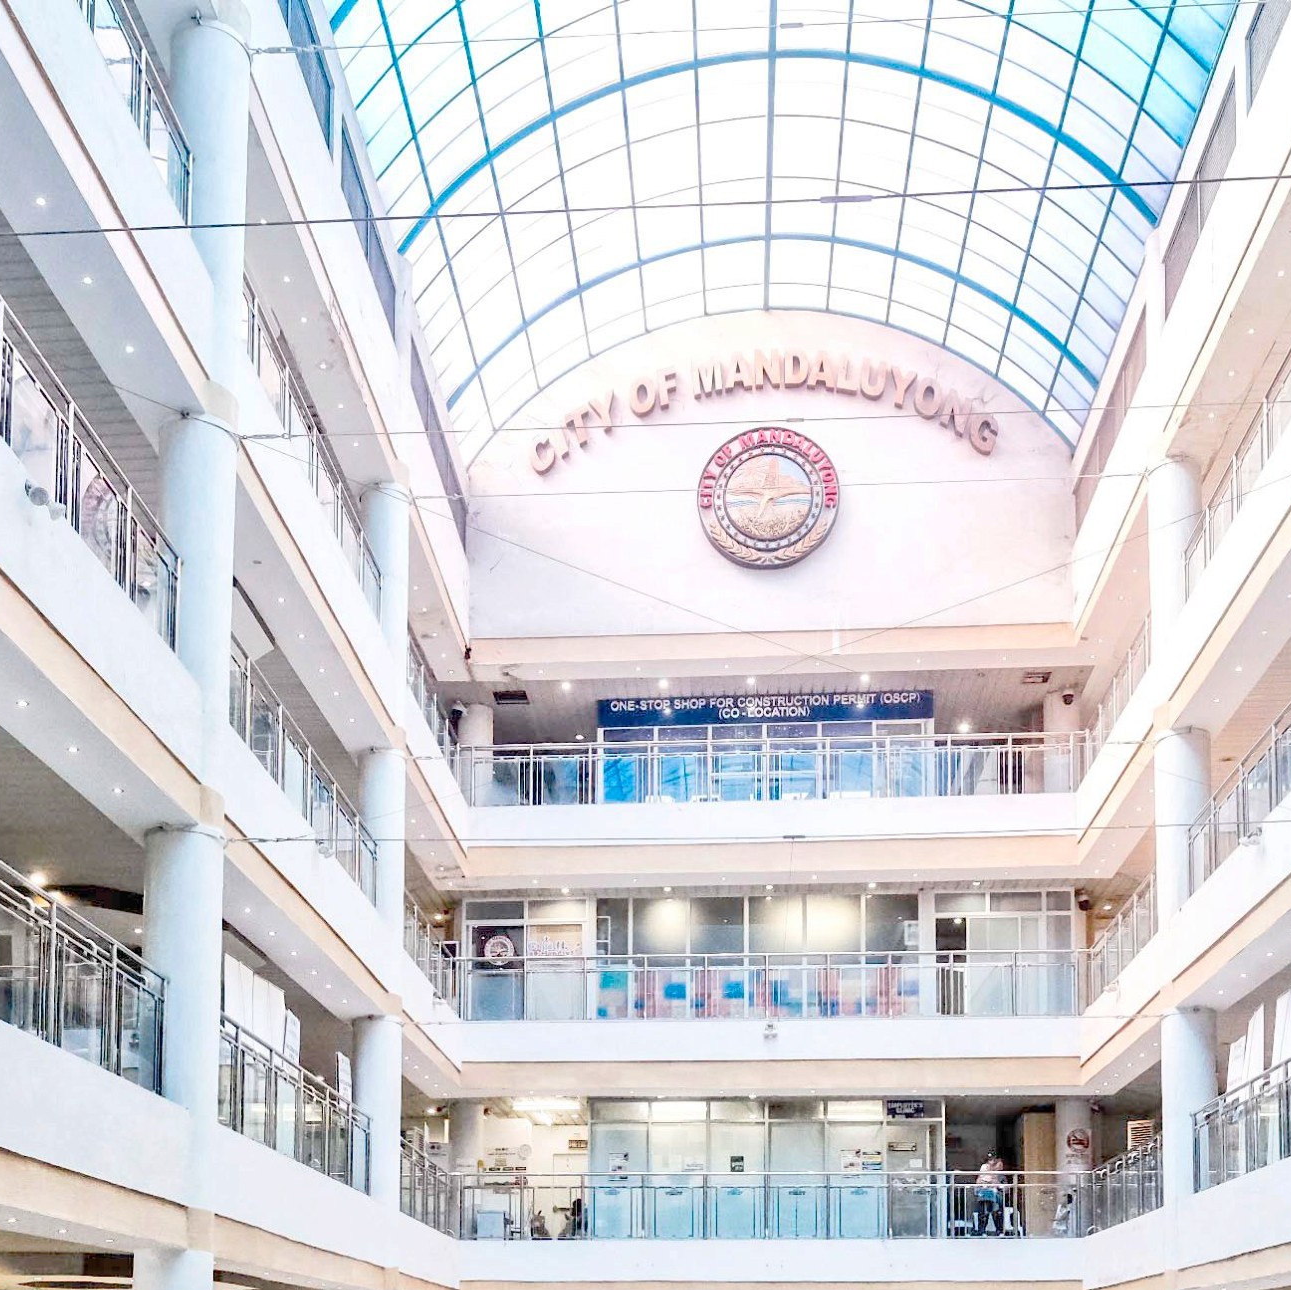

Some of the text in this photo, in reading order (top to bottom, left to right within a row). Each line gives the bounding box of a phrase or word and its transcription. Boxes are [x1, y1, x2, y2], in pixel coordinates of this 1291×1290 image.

[528, 348, 1001, 476] CITY OF MANDALUYONG
[700, 429, 838, 509] CITY OF MANDALUYONG
[610, 691, 921, 713] ONE-STOP SHOP FOR CONSTRUCTION PERMIT (OSCP)
